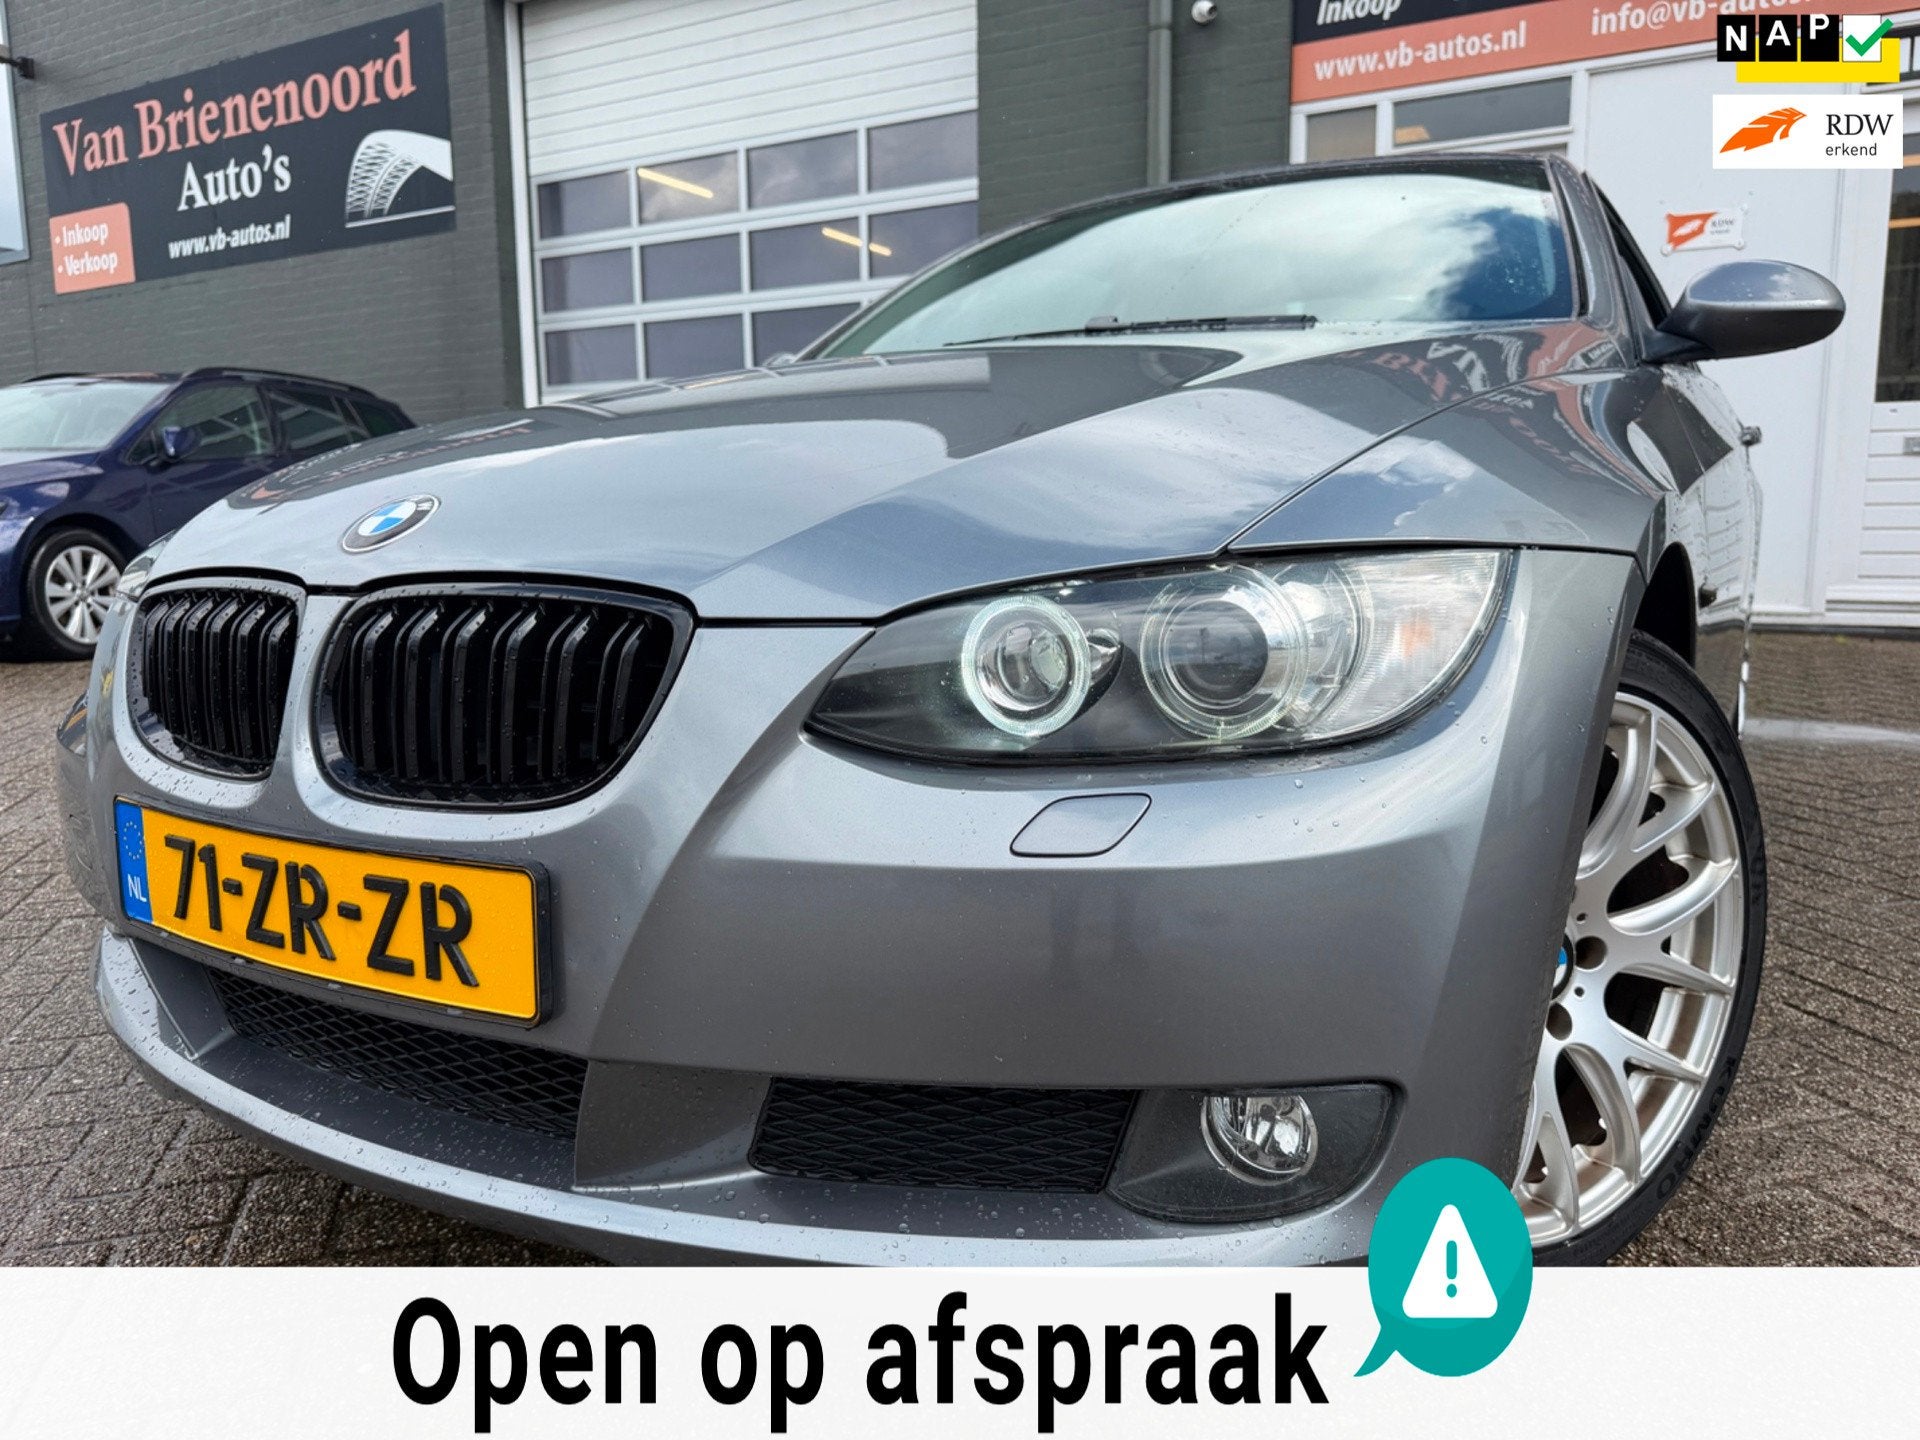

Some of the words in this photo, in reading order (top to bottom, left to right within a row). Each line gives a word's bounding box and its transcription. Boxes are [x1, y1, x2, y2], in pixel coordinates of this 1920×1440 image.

[1316, 0, 1401, 26] Inkoop
[1314, 20, 1527, 80] www.vb-autos.nl
[1591, 0, 1800, 36] info@vb-au
[53, 118, 129, 177] Van
[134, 29, 417, 160] Brienenoord
[62, 222, 109, 247] Inkoop
[168, 214, 291, 260] www.vb-autos.nl
[64, 252, 118, 277] Verkoop
[126, 872, 147, 903] NL
[164, 834, 480, 987] 71-ZR-ZR
